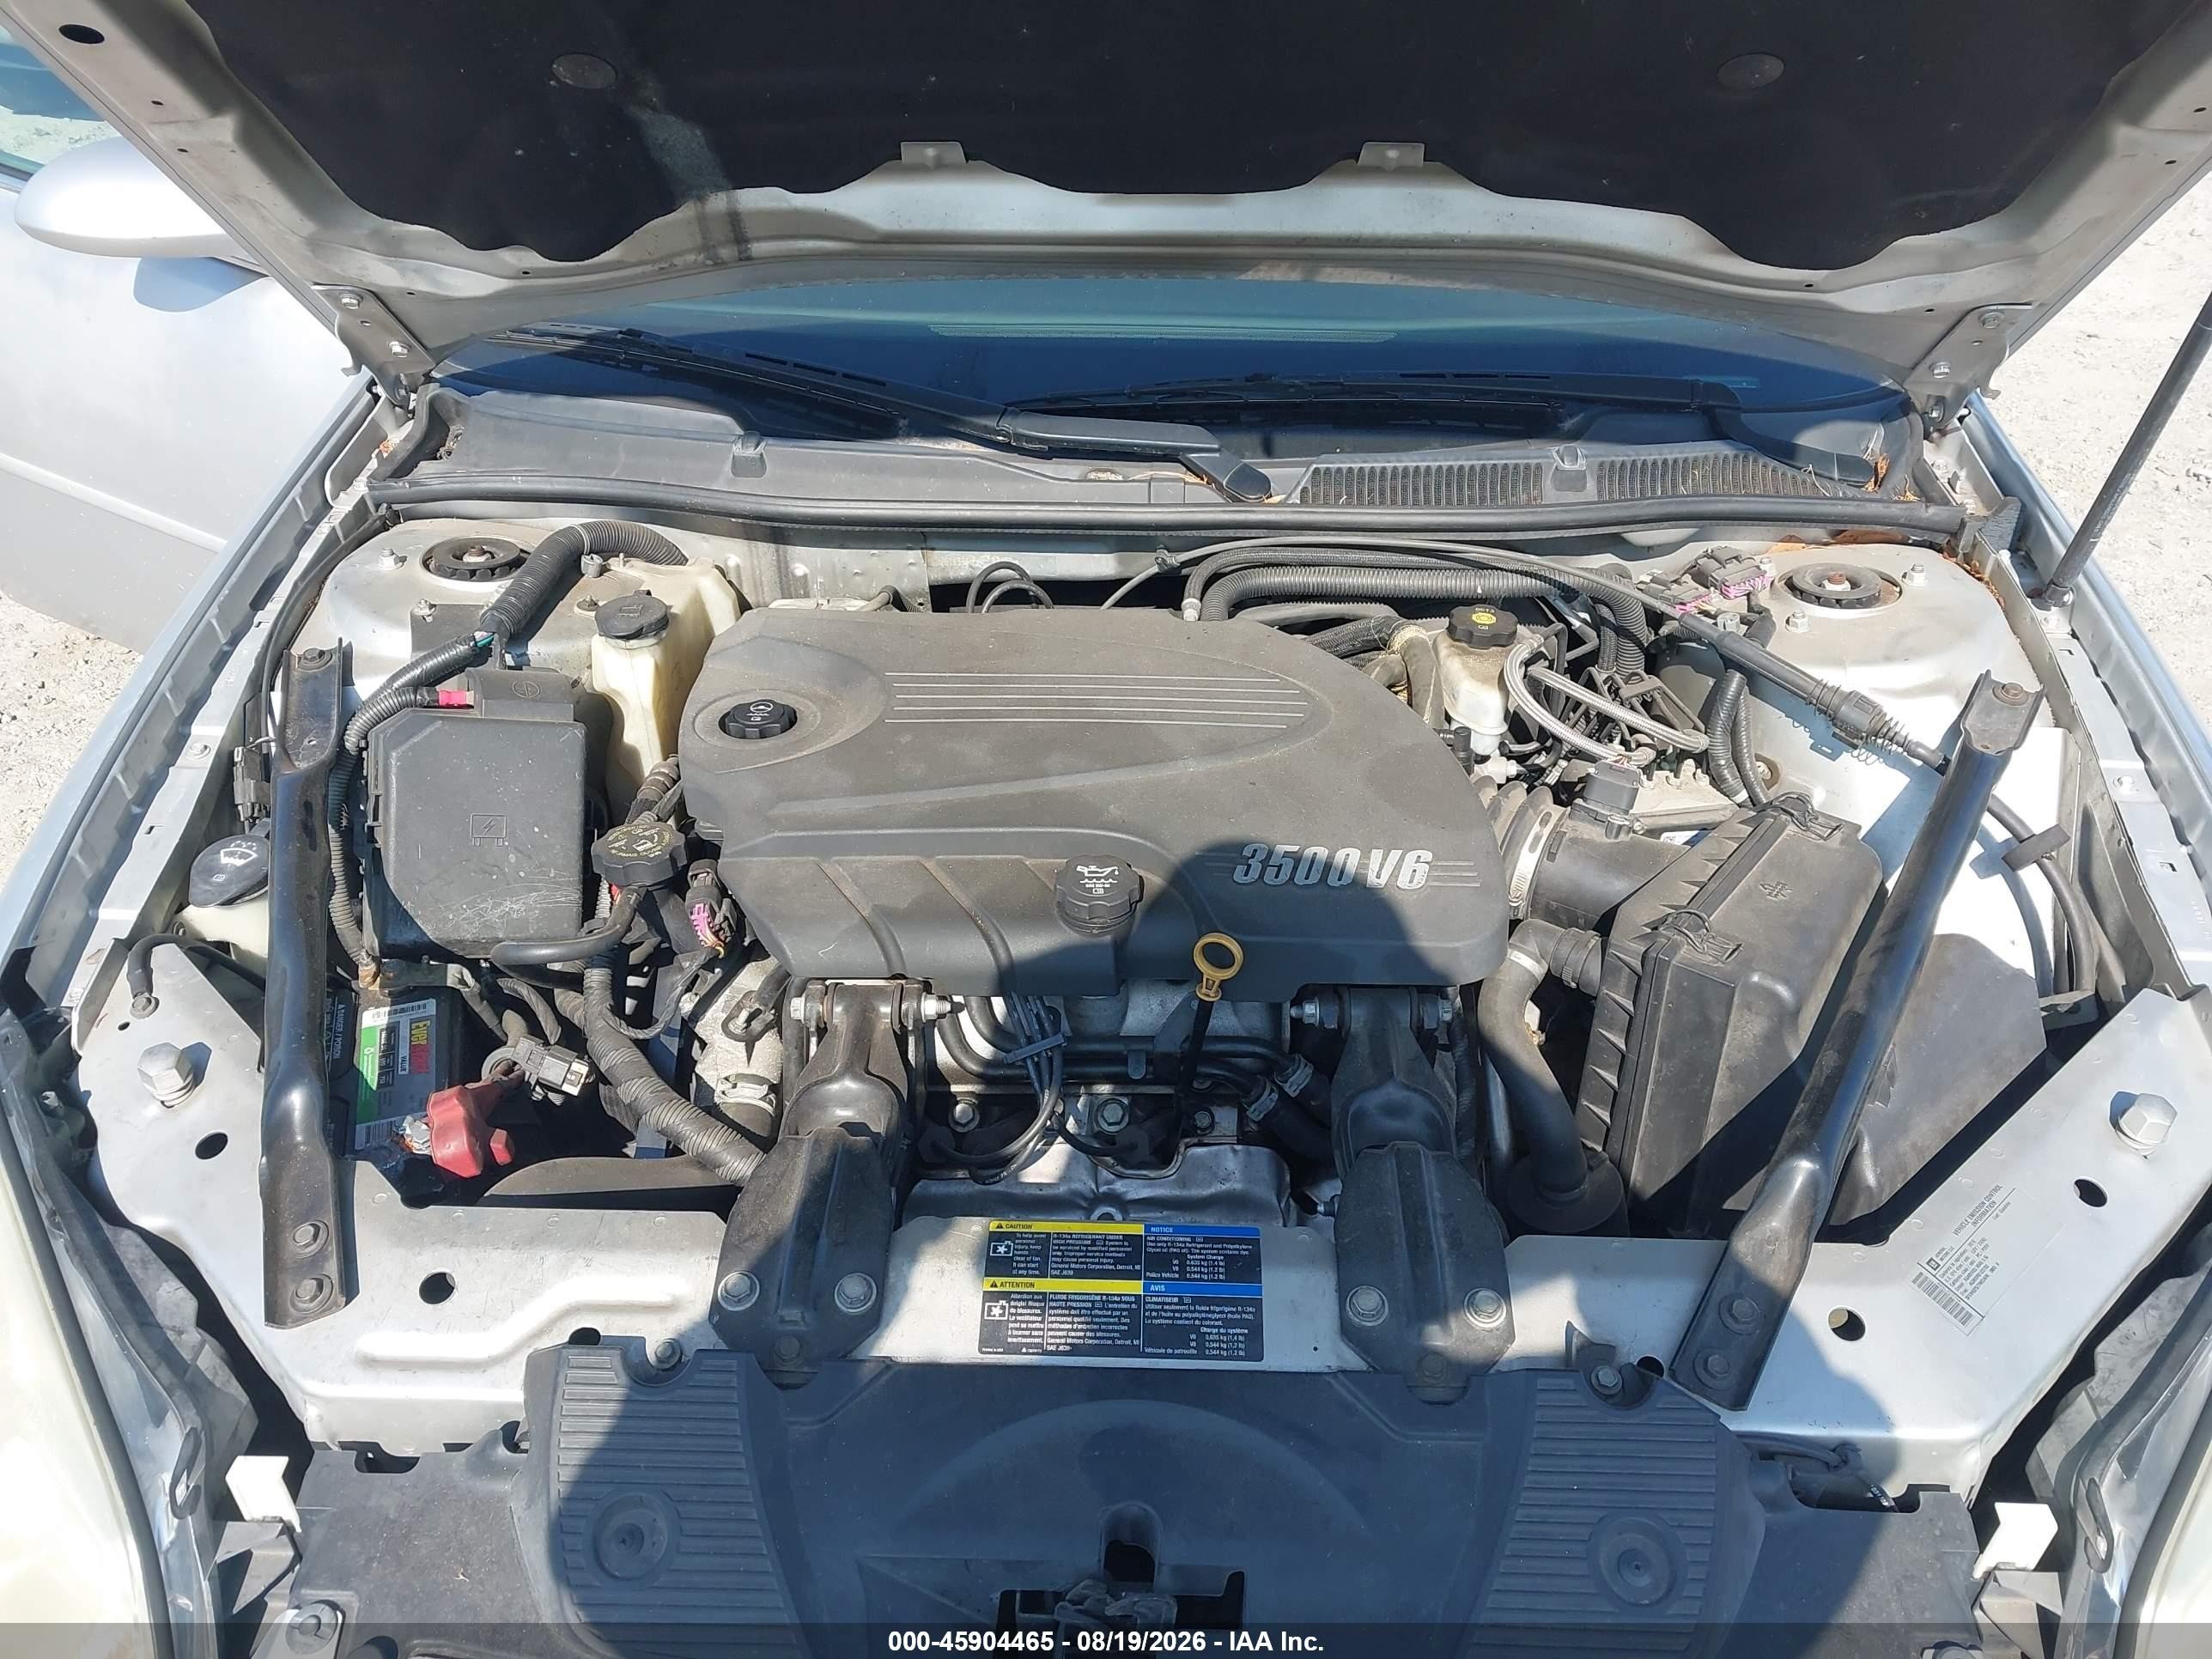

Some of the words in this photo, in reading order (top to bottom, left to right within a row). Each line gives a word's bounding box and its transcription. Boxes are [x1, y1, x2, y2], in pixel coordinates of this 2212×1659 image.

[1232, 843, 1361, 887] 3500
[1366, 848, 1434, 890] V6
[336, 1009, 344, 1031] DANGER
[333, 1037, 343, 1059] POISON
[1953, 1218, 1970, 1236] VEHICLE
[1967, 1201, 1987, 1220] EMISSION
[1984, 1185, 2002, 1201] CONTROL
[1971, 1200, 1996, 1227] INFORMATION
